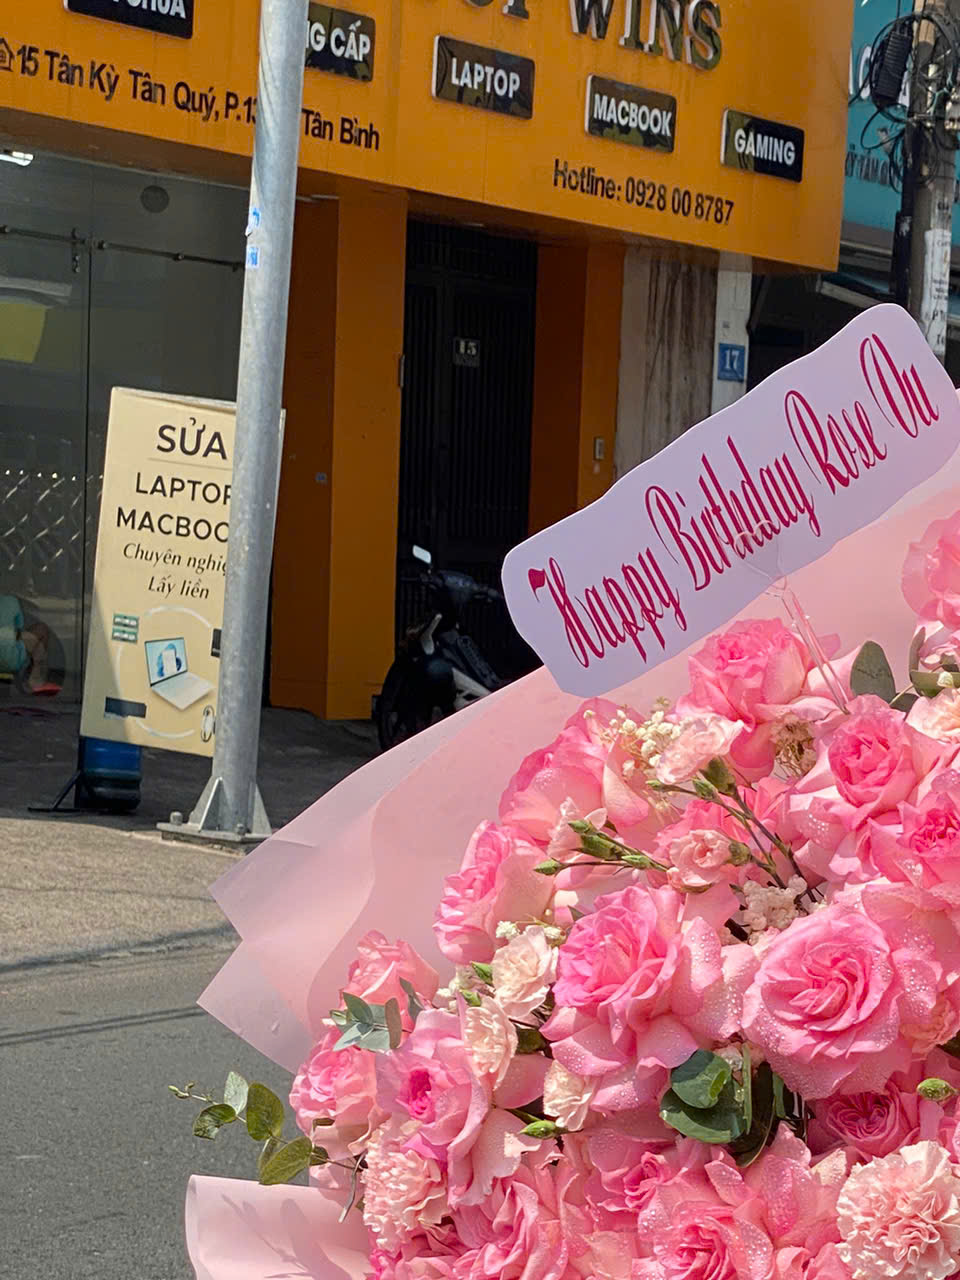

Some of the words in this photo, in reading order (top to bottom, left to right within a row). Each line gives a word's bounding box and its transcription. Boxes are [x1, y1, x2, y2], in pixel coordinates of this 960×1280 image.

[330, 21, 372, 63] CẤP
[16, 45, 40, 77] 15
[44, 50, 84, 88] Tân
[90, 61, 120, 102] Kỳ
[129, 69, 166, 107] Tân
[173, 81, 219, 122] Quý,
[302, 108, 333, 142] Tân
[339, 117, 380, 151] Bình
[451, 57, 521, 99] LAPTOP
[593, 94, 672, 138] MACBOOK
[734, 127, 796, 166] GAMING
[553, 158, 621, 202] Hotline:
[625, 177, 667, 212] 0928
[672, 187, 691, 217] 00
[694, 193, 735, 226] 8787
[724, 349, 740, 370] 17
[156, 417, 227, 460] SỬA
[116, 506, 230, 543] MACBOO
[527, 556, 688, 668] Happy
[644, 436, 821, 593] Birthday
[784, 390, 888, 495] Rose
[123, 543, 182, 568] Chuyên
[148, 575, 177, 599] Lấy
[179, 577, 209, 600] liền
